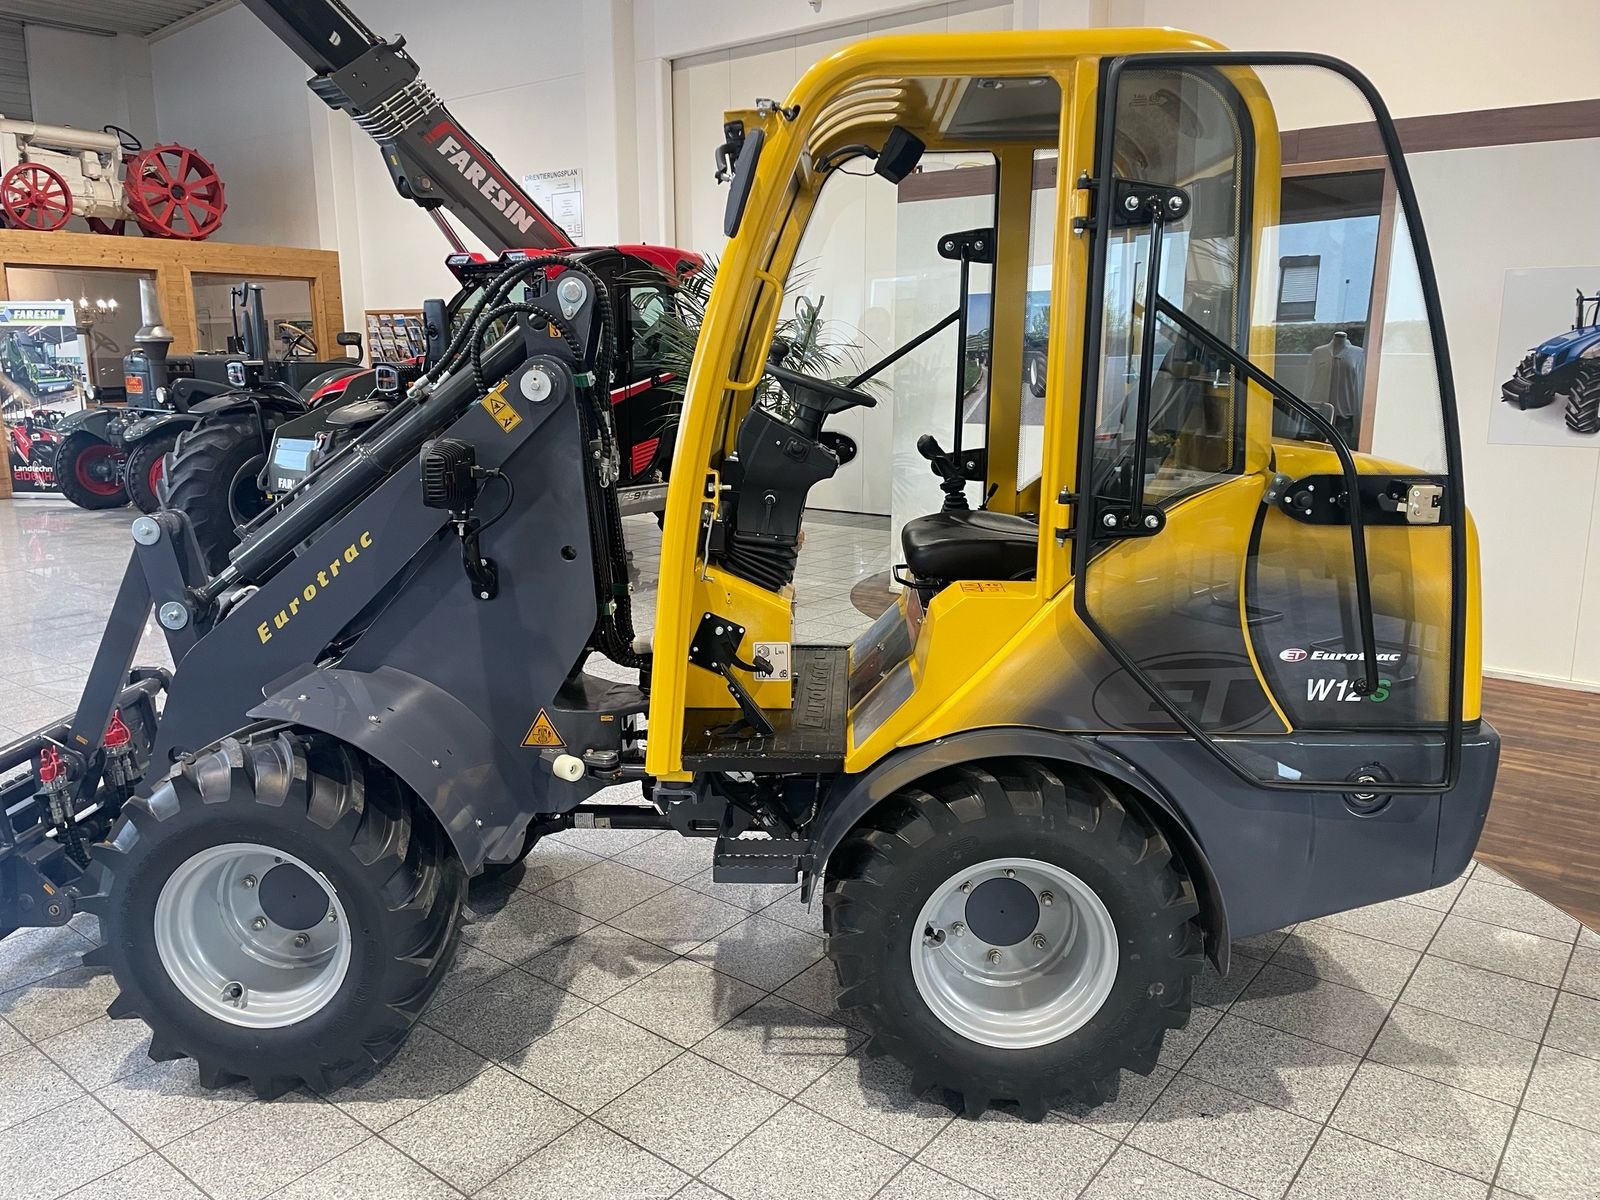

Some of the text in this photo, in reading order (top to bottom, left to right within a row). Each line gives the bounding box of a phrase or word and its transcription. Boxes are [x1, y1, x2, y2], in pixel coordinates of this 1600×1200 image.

[525, 169, 578, 181] ORIENTIERUNGSPLAN
[437, 136, 535, 233] FARESIN
[13, 309, 59, 320] FARESIN
[257, 531, 373, 644] Eurotrac
[1310, 651, 1401, 661] Eurotac
